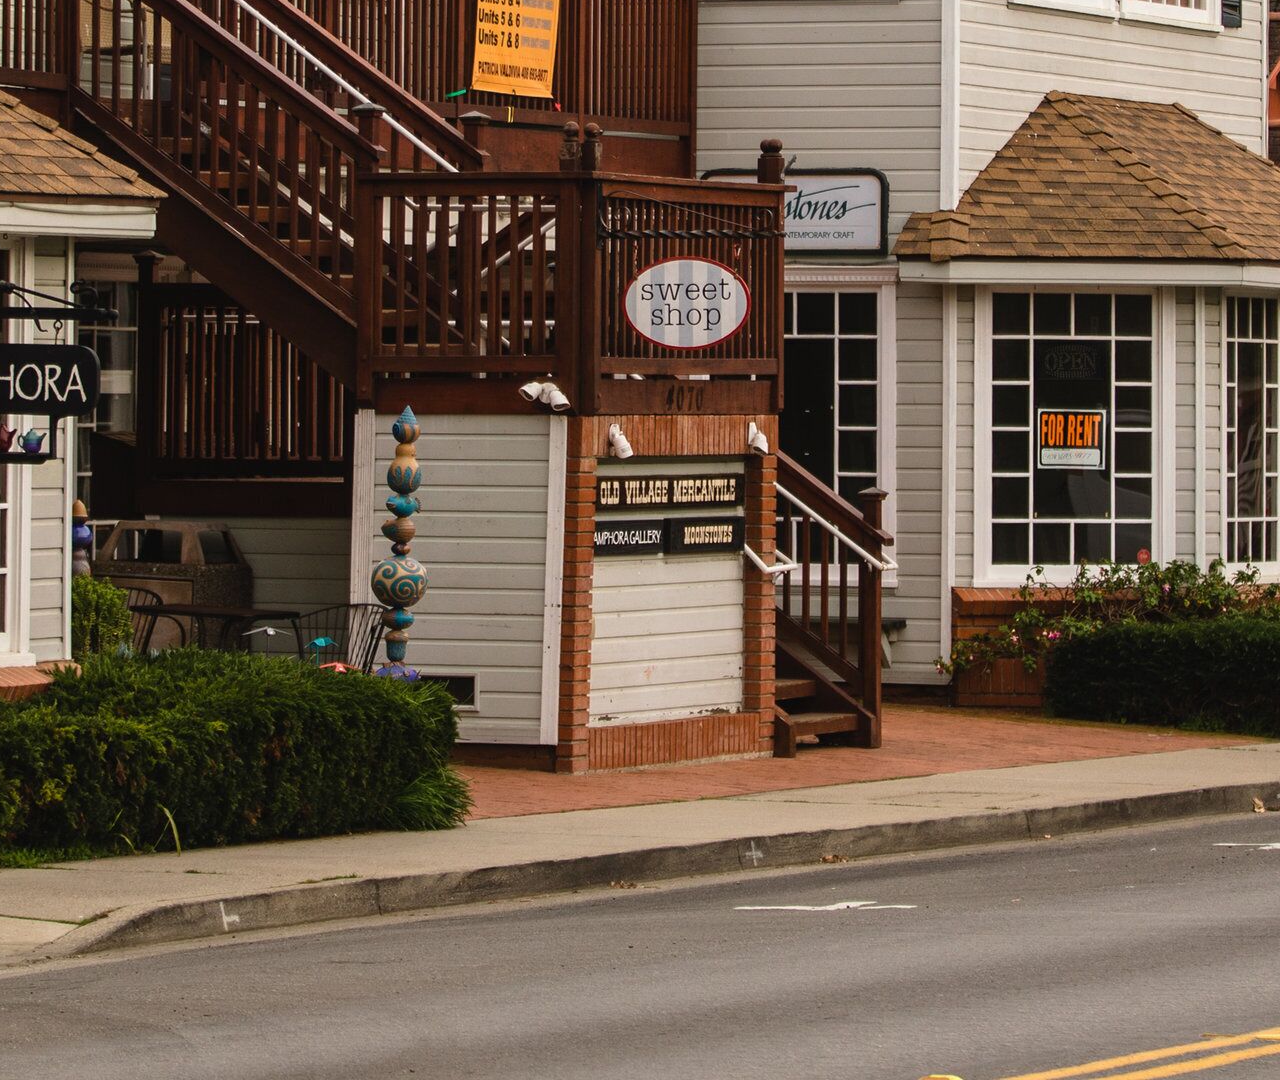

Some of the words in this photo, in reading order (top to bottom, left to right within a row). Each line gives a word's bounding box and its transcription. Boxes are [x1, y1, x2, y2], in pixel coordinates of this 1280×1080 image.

[478, 7, 499, 25] Units
[500, 10, 506, 26] 5
[507, 12, 513, 27] &
[515, 13, 521, 28] 6
[478, 28, 499, 47] Units
[500, 31, 506, 47] 7
[506, 32, 513, 48] &
[514, 33, 520, 49] 8
[478, 61, 499, 76] PATRICIA
[833, 231, 855, 240] CRAFT
[641, 278, 732, 301] sweet
[651, 303, 721, 331] shop
[1041, 413, 1065, 446] FOR
[1067, 414, 1102, 447] RENT
[600, 481, 620, 505] OLD
[625, 480, 669, 505] VILLAGE
[673, 478, 736, 503] MERCANTILE
[593, 530, 629, 546] AMPHORA
[630, 529, 662, 545] GALLERY
[683, 525, 733, 545] MOONSTONES
